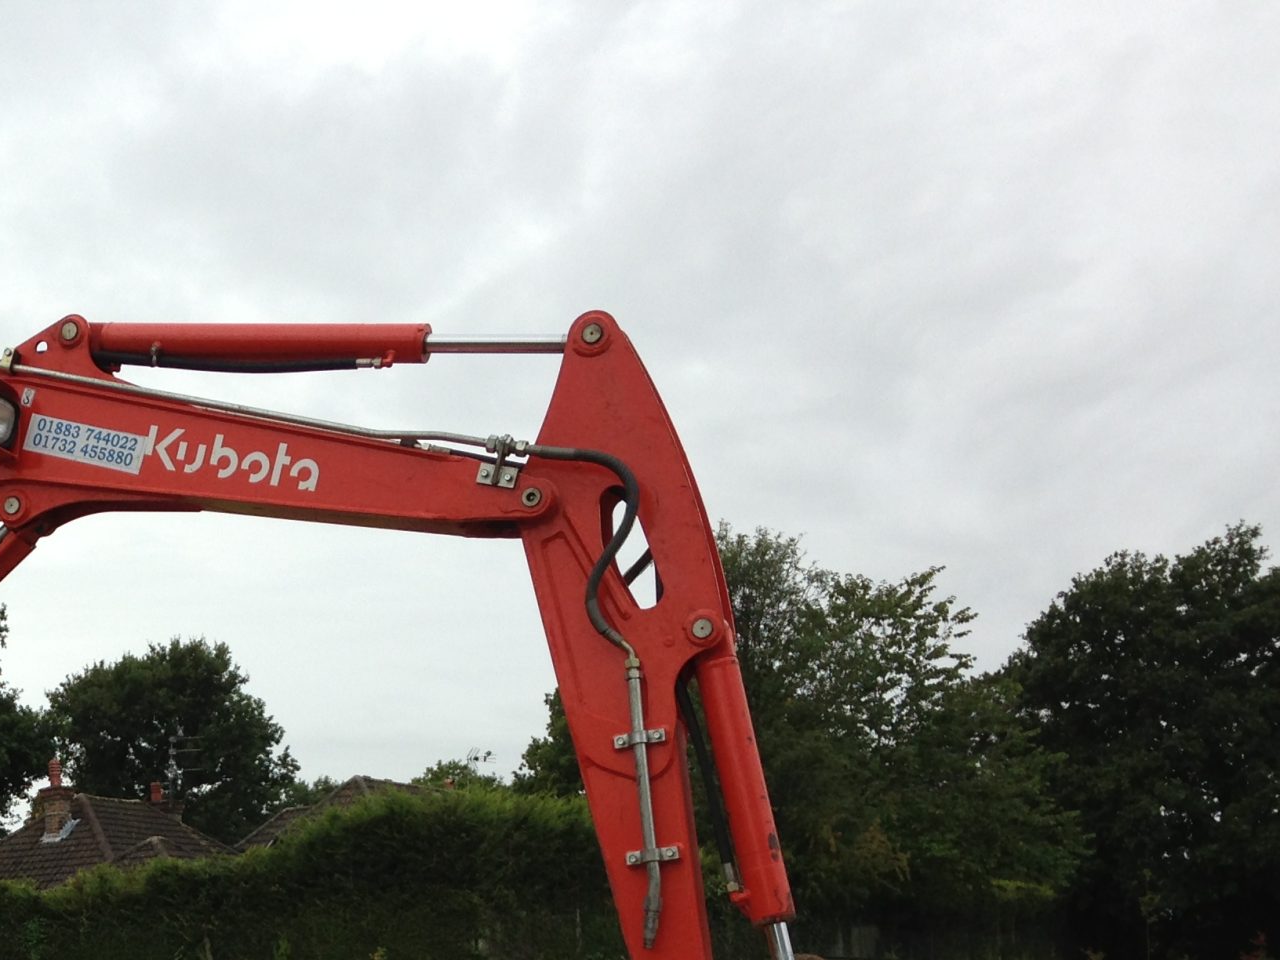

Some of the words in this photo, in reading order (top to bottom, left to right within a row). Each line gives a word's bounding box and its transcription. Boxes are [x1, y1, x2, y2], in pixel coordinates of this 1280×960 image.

[32, 432, 77, 455] 01732
[80, 443, 133, 467] 455880
[37, 418, 81, 439] 01883
[85, 427, 138, 452] 744022
[143, 424, 320, 492] Kubota
